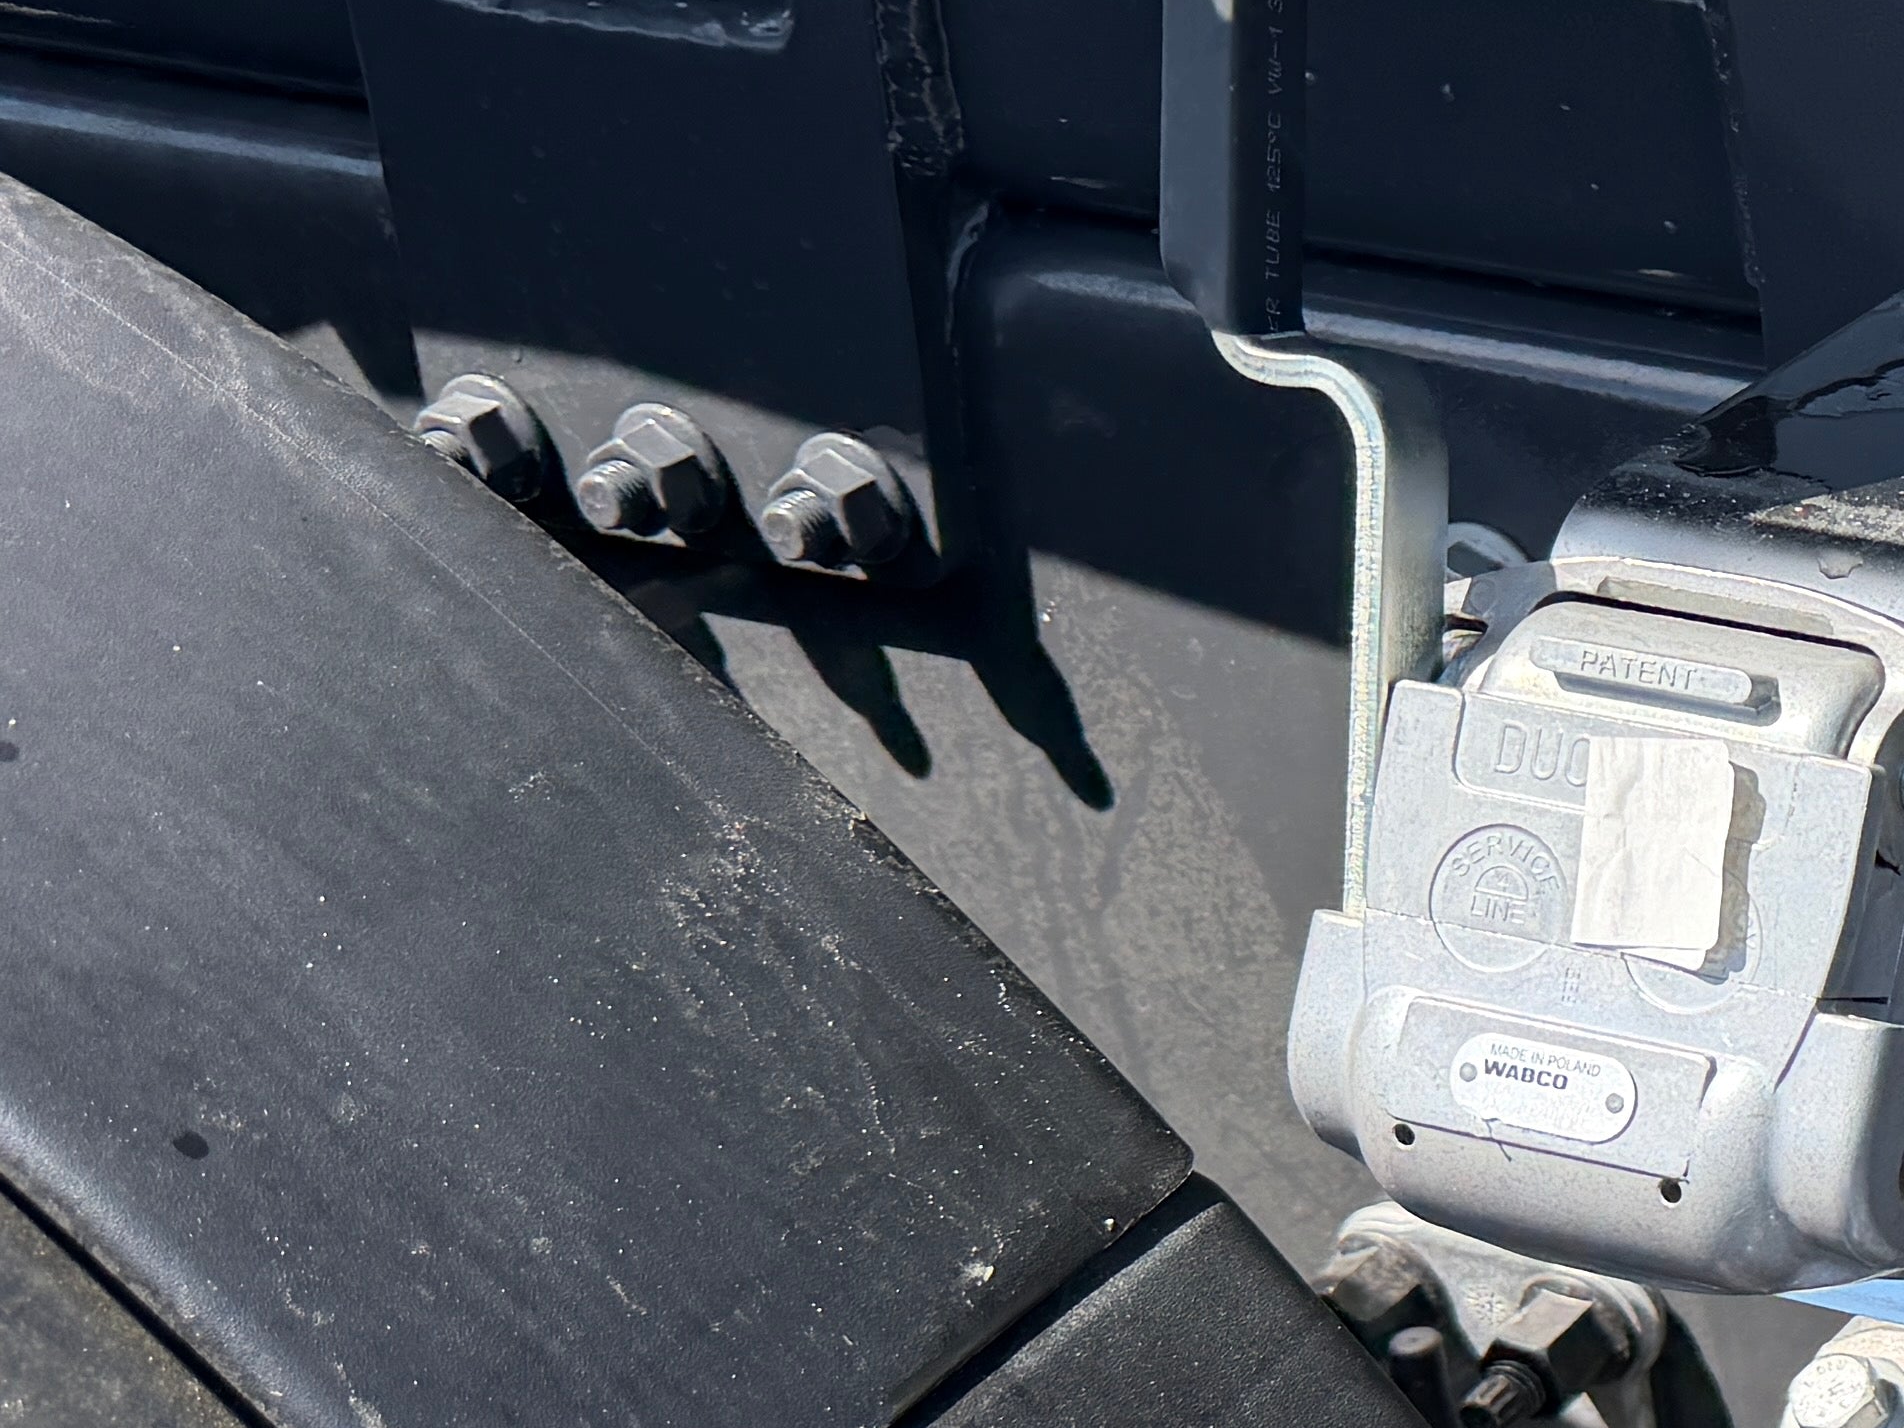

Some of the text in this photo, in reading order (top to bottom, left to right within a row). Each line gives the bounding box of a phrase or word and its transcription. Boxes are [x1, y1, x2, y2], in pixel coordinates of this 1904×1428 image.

[1266, 26, 1284, 96] VW-1
[1264, 210, 1282, 280] TUBE
[1580, 649, 1698, 691] PATENT
[1450, 834, 1561, 895] SERVICE
[1469, 894, 1529, 924] LINE
[1483, 1057, 1569, 1091] WABCO
[1489, 1042, 1602, 1078] MADE IN POLAND
